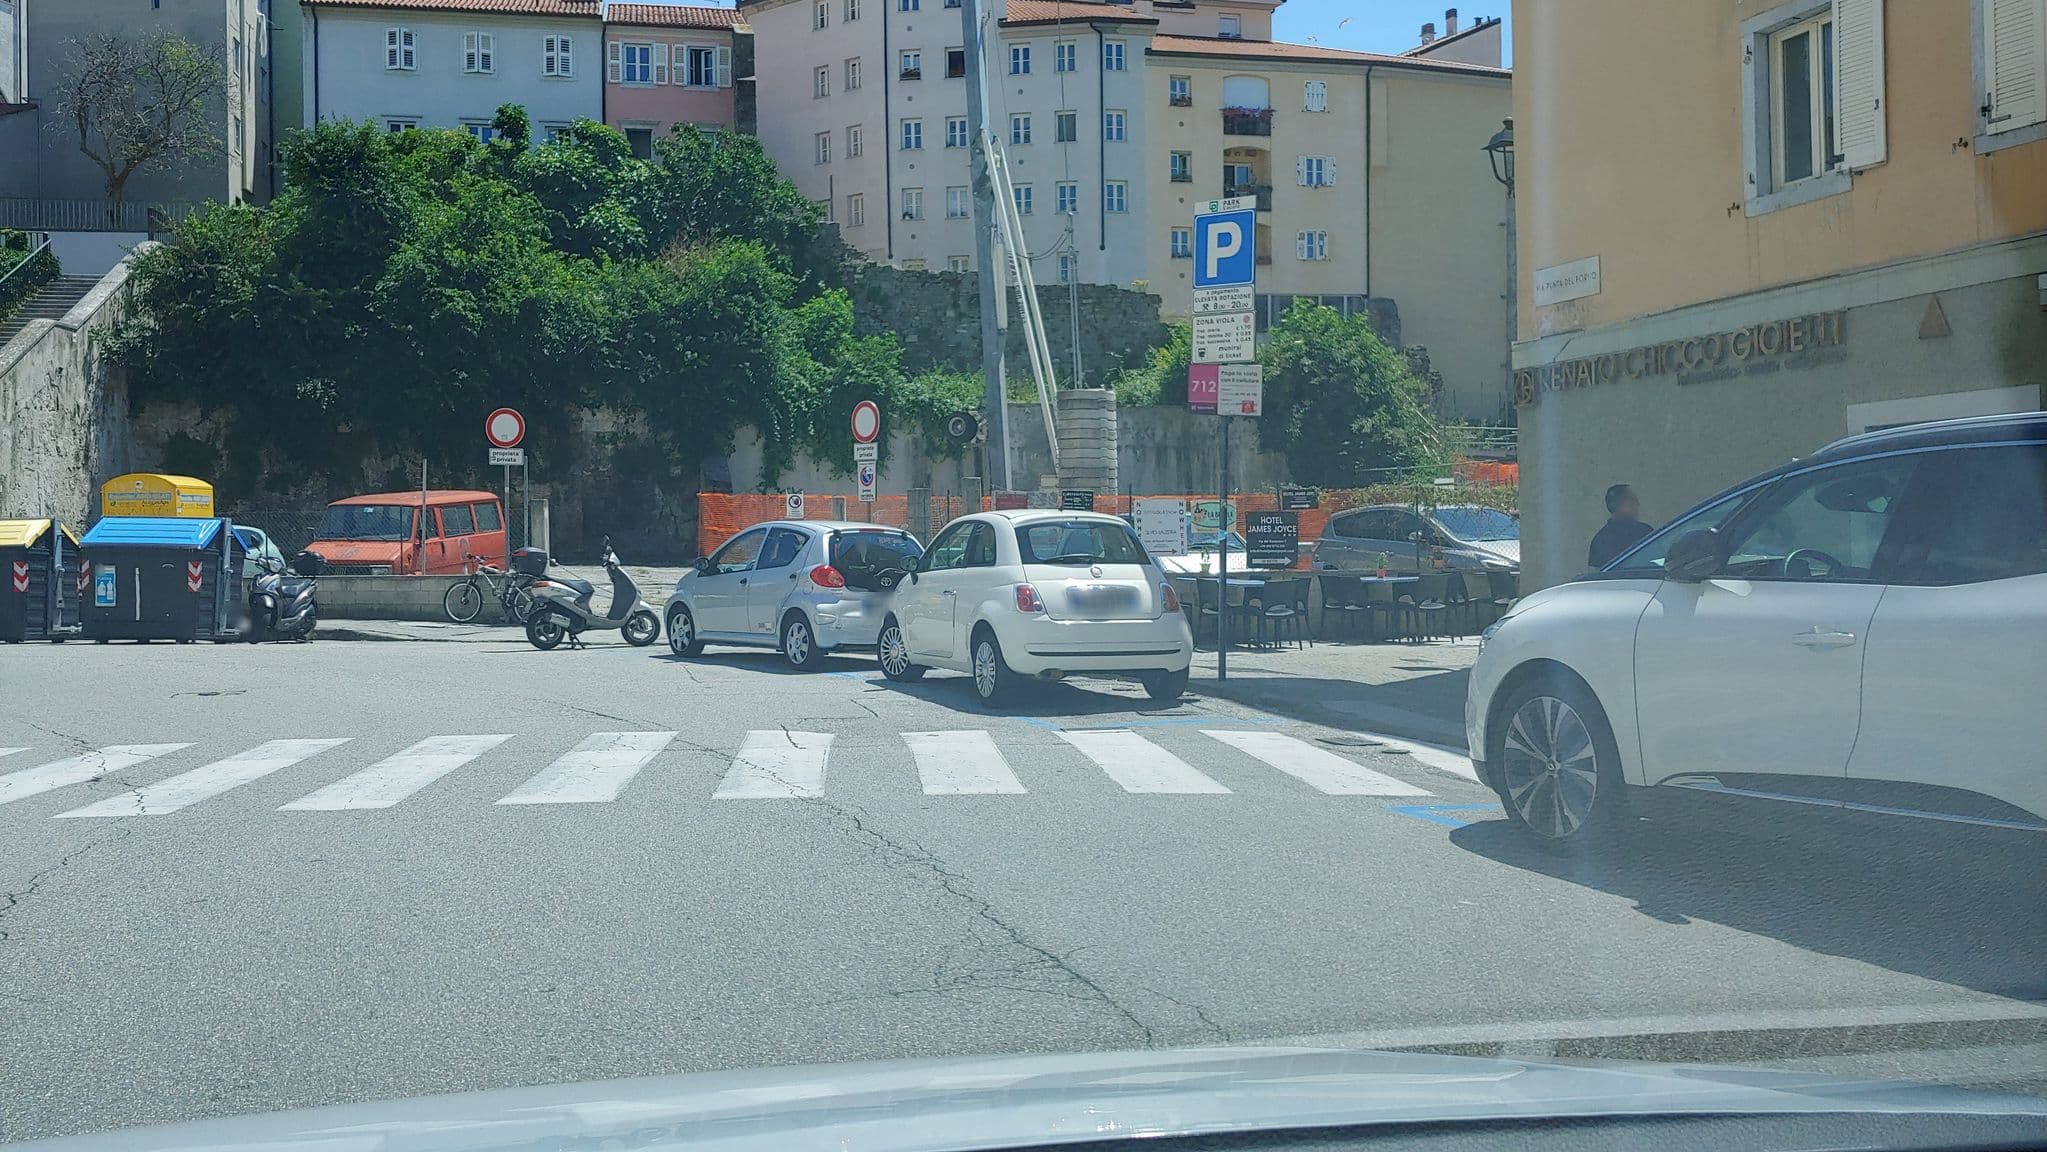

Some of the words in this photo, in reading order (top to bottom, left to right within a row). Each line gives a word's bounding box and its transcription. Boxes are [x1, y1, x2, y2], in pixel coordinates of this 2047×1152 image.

[1206, 220, 1242, 279] P
[1196, 318, 1214, 326] ZONA
[1538, 353, 1616, 394] RENATO
[1624, 335, 1721, 380] CHICCO
[1191, 380, 1217, 393] 712
[1260, 516, 1283, 524] HOTEL
[1248, 525, 1271, 533] JAMES
[1273, 525, 1297, 533] JOYCE
